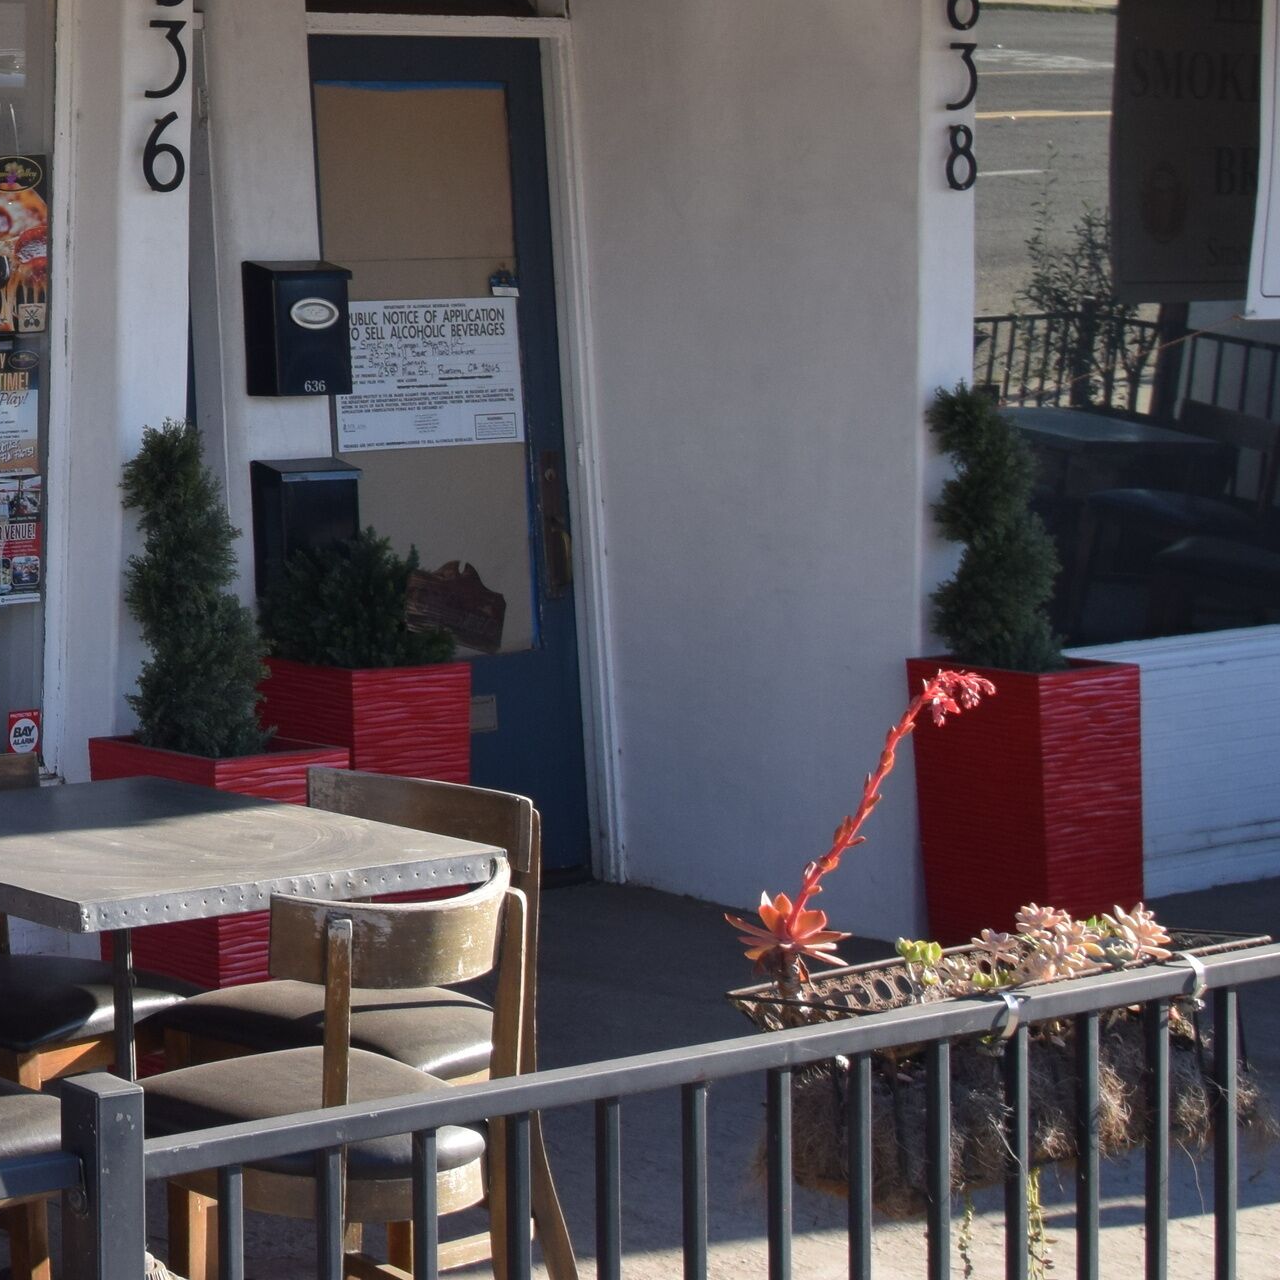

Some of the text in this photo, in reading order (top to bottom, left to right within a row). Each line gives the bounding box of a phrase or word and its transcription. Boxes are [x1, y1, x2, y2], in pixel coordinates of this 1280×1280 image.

[383, 310, 419, 325] NOTICE
[424, 310, 438, 324] OF
[443, 308, 505, 323] APPLICATION
[365, 326, 385, 340] SELL
[390, 324, 445, 339] ALCOHOLIC
[451, 322, 505, 337] BEVERAGES
[303, 380, 327, 393] 636
[0, 392, 29, 407] Play!
[5, 523, 36, 540] VENUE!
[13, 725, 35, 738] BAY
[12, 737, 34, 746] ALARM
